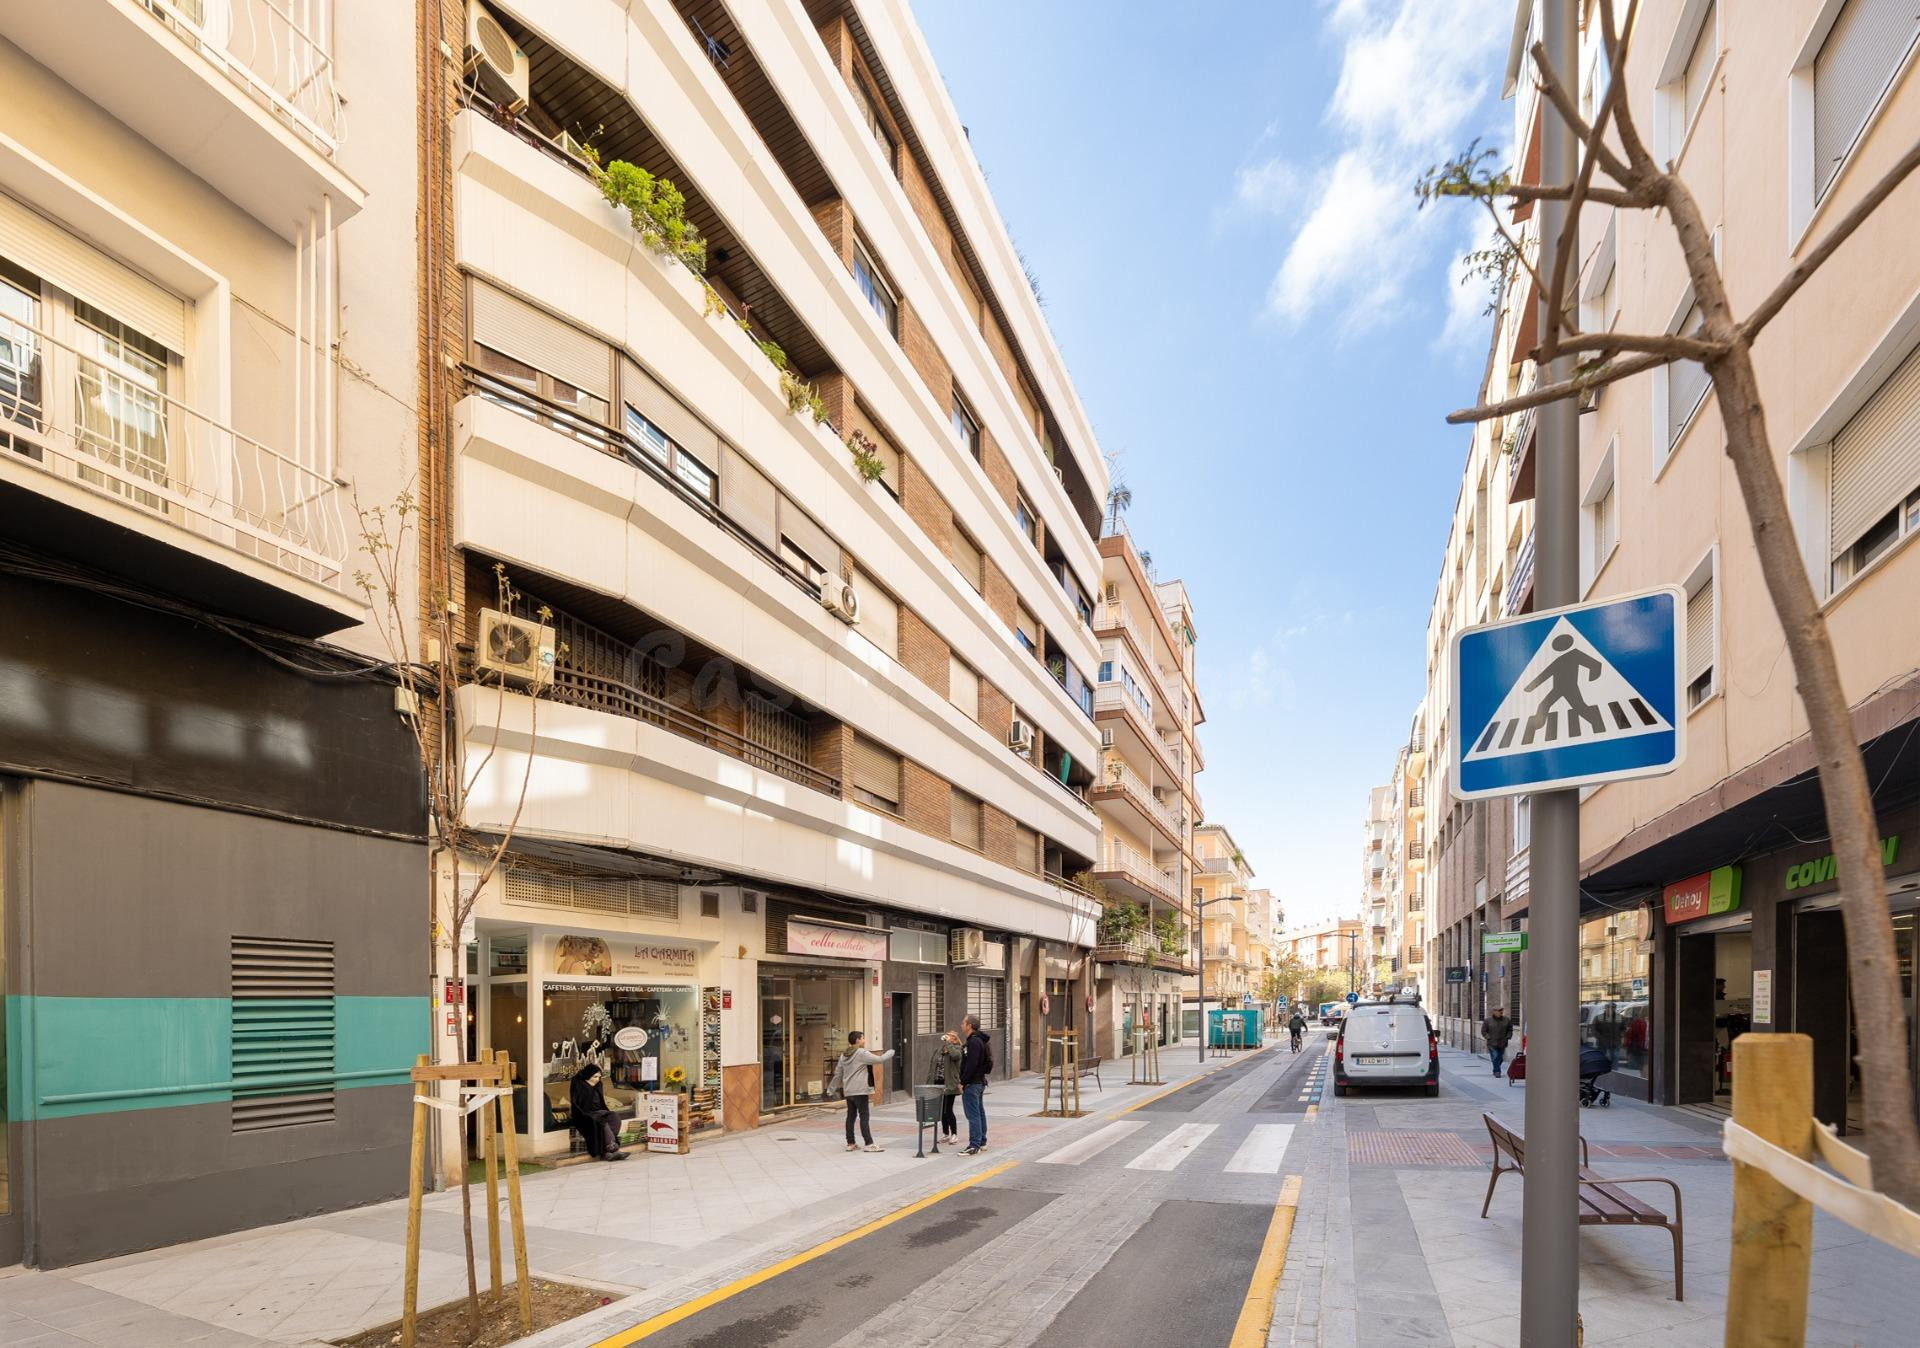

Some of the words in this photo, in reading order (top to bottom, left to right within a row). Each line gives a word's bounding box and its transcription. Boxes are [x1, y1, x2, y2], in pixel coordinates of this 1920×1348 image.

[1785, 835, 1899, 890] COVIN
[634, 945, 649, 960] LA
[650, 946, 695, 962] CARMITA
